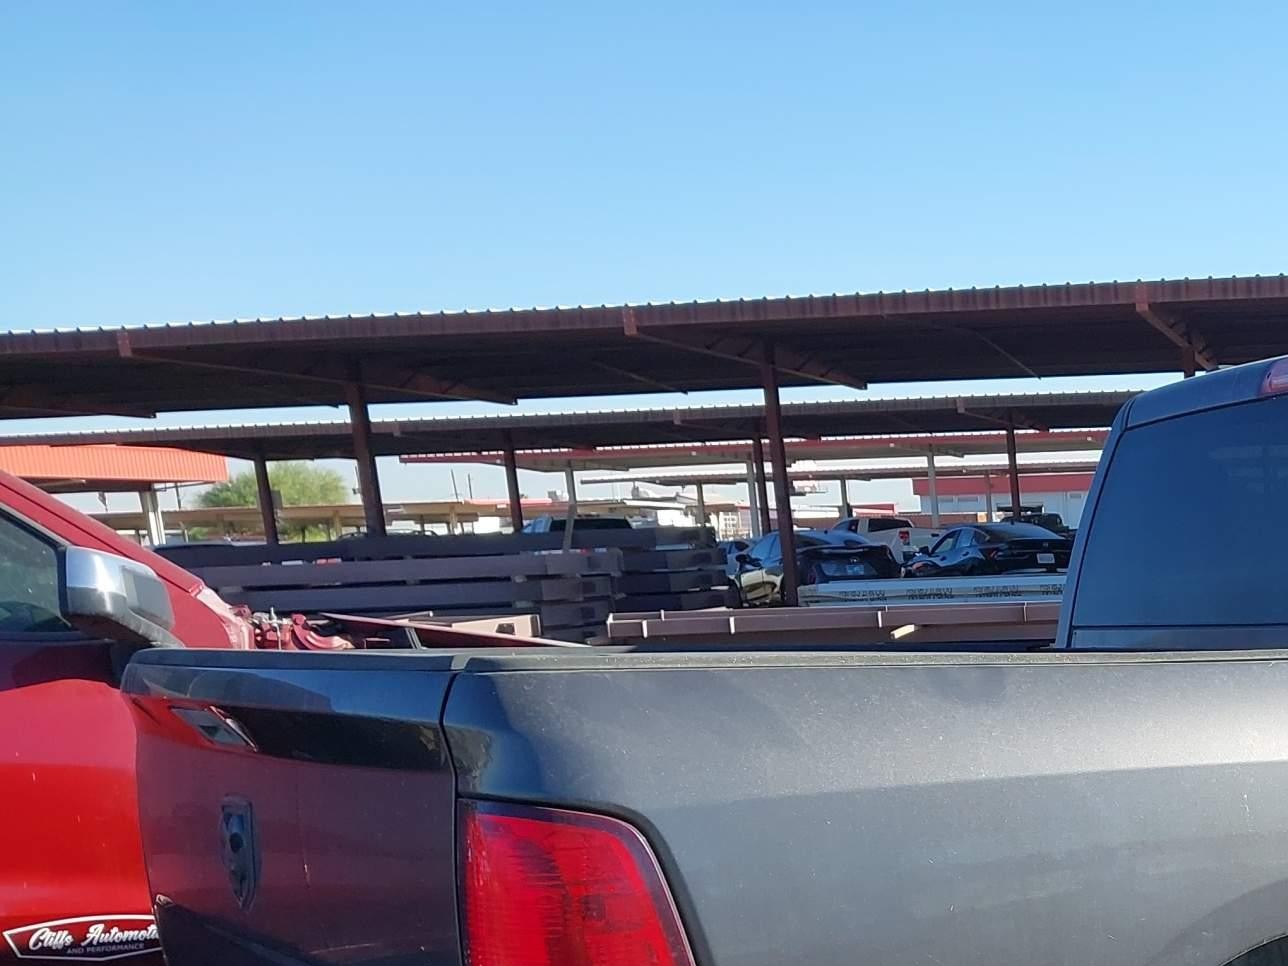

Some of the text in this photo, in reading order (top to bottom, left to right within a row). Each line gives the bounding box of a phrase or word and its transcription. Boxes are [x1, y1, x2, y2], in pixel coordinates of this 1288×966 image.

[29, 927, 73, 950] Cliffs
[67, 942, 145, 954] AND PERFORMANCE
